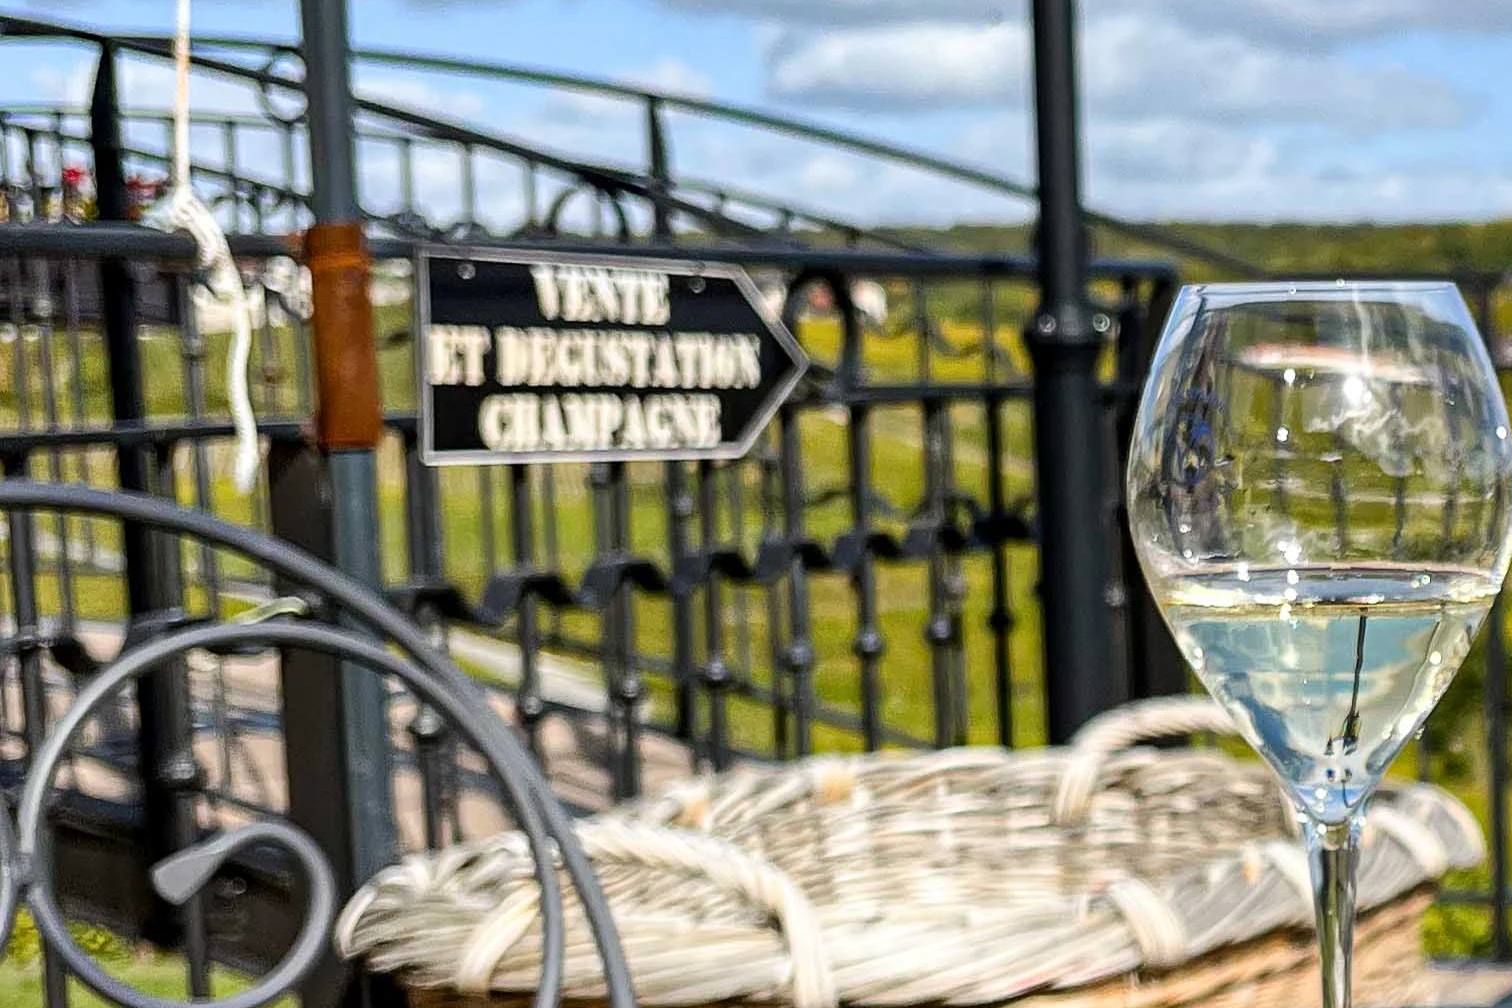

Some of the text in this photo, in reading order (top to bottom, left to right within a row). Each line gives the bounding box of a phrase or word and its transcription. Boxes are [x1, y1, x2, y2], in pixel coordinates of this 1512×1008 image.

[531, 265, 671, 325] VENTE
[427, 325, 761, 389] ET DEGUSTATION
[479, 393, 722, 450] CHAMPAGNE
